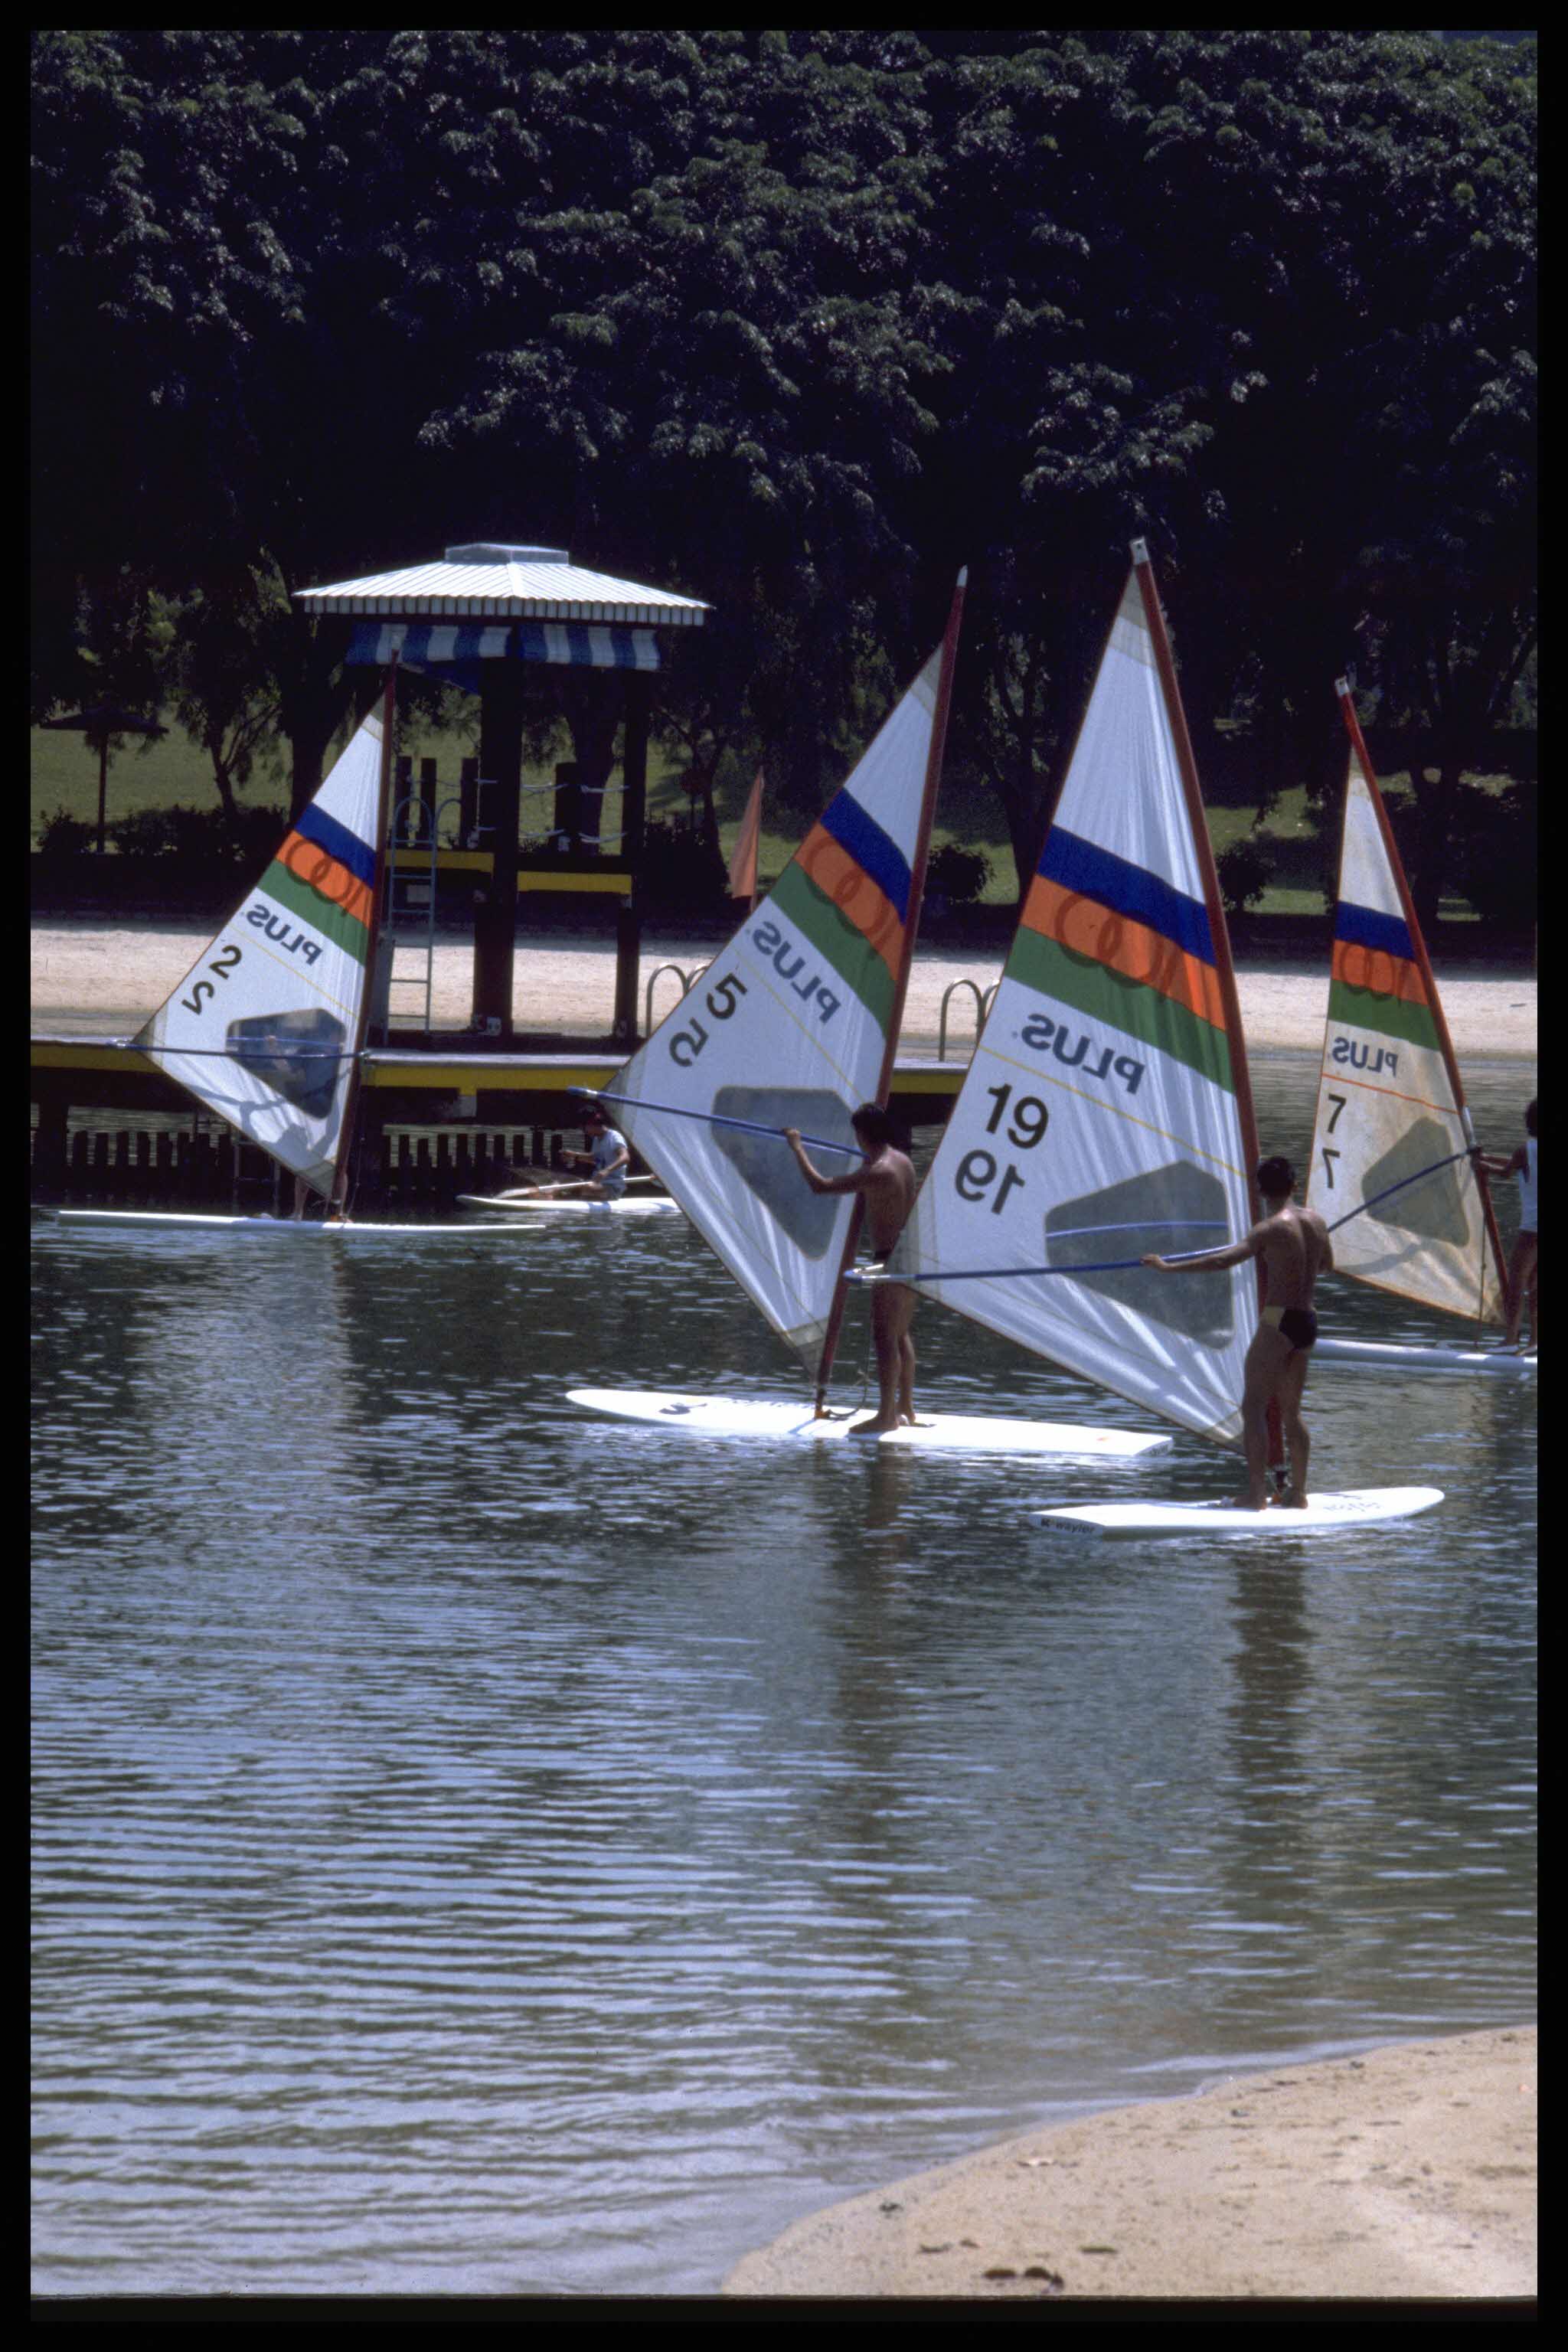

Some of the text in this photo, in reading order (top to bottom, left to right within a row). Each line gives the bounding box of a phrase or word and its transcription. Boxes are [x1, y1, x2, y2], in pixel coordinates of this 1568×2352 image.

[208, 945, 242, 979] 2
[707, 973, 748, 1020] 5
[986, 1083, 1049, 1149] 19
[1328, 1093, 1347, 1134] 7
